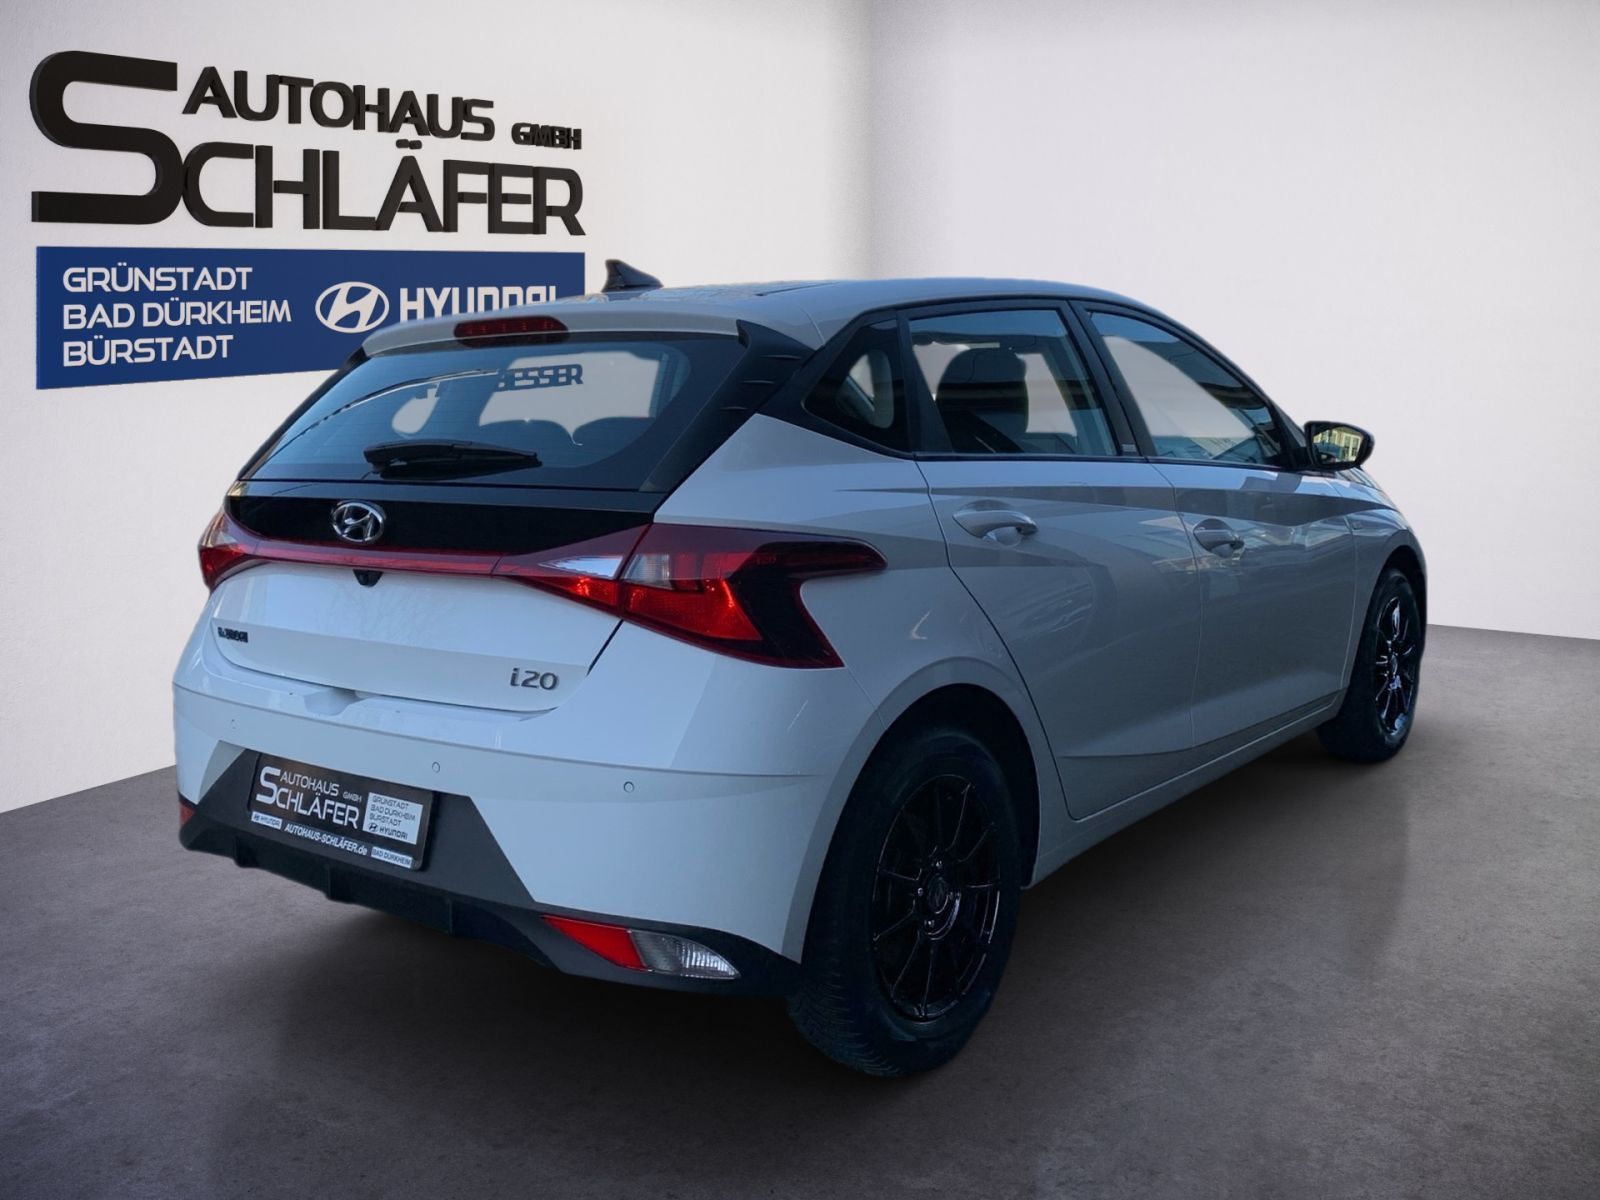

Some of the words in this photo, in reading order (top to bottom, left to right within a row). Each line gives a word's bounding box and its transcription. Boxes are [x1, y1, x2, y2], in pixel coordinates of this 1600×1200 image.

[182, 66, 494, 141] AUTOHAUS
[29, 50, 586, 236] SCHLÄFER
[63, 262, 253, 293] GRÜNSTADT
[63, 303, 135, 330] BAD
[142, 297, 292, 327] DÜRKHEIM
[63, 335, 234, 367] BÜRSTADT
[510, 667, 559, 691] i20
[256, 766, 359, 829] SCHLÄFER
[280, 771, 339, 797] AUTOHAUS
[370, 804, 385, 814] BAD
